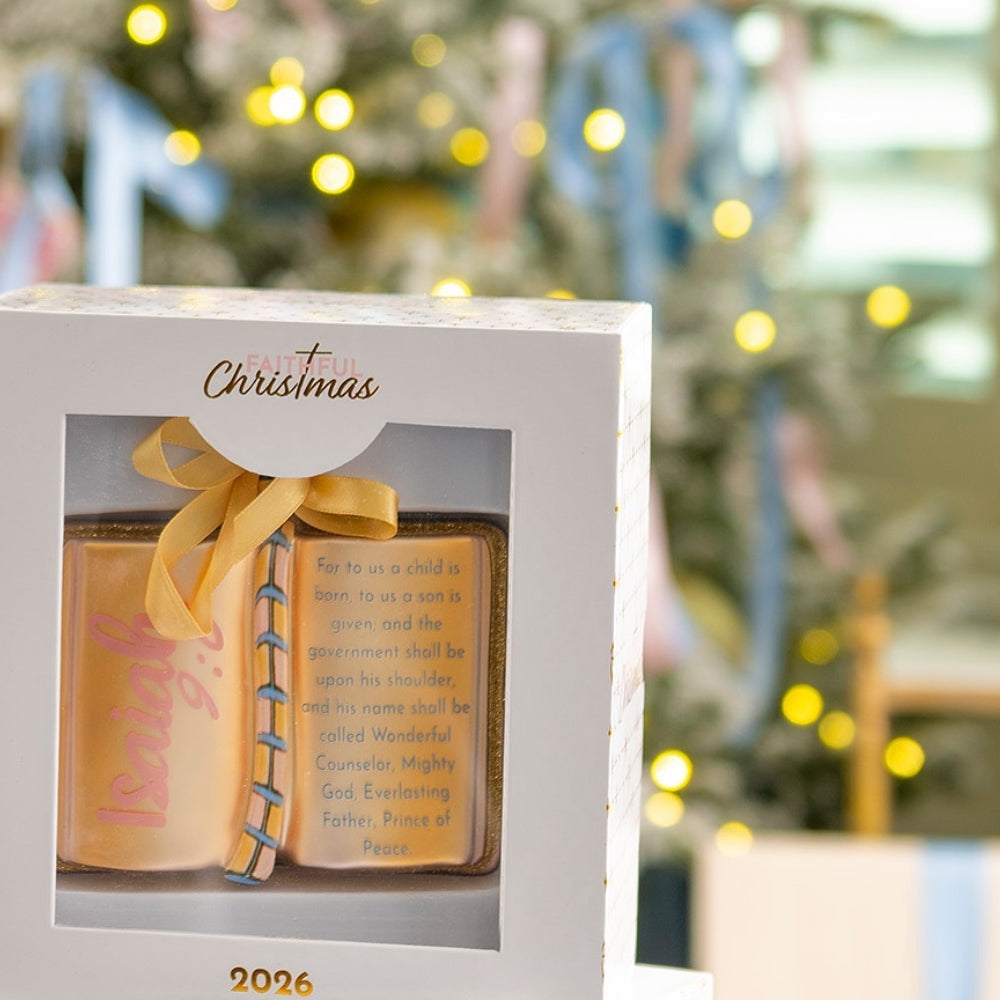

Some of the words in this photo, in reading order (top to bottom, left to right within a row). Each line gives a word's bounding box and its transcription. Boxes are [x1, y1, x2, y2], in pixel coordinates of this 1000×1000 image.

[203, 342, 380, 400] Christmas
[246, 354, 363, 377] FAITHFUL
[317, 557, 340, 574] For
[347, 561, 362, 574] to
[369, 563, 384, 574] us
[391, 563, 400, 574] a
[407, 559, 443, 574] child
[449, 560, 460, 574] is
[315, 586, 352, 603] born,
[359, 590, 374, 602] to
[381, 592, 396, 602] us
[403, 592, 412, 602] a
[420, 591, 444, 602] son
[450, 589, 461, 602] is
[382, 615, 412, 630] and
[419, 615, 443, 630] the
[308, 645, 399, 660] government
[406, 642, 440, 658] shall
[447, 642, 465, 658] be
[316, 675, 354, 687] upon
[360, 670, 381, 686] his
[388, 670, 456, 688] shoulder,
[301, 699, 329, 714] and
[335, 699, 356, 714] his
[363, 703, 404, 714] name
[411, 699, 446, 714] shall
[453, 699, 470, 714] be
[87, 613, 177, 828] Isaiah
[320, 727, 364, 742] called
[372, 725, 452, 742] Wonderful
[316, 754, 395, 772] Counselor,
[402, 754, 456, 774] Mighty
[322, 783, 357, 800] God,
[364, 783, 450, 802] Everlasting
[322, 812, 376, 829] Father,
[383, 810, 429, 827] Prince
[436, 810, 451, 826] of
[230, 966, 314, 997] 2026
